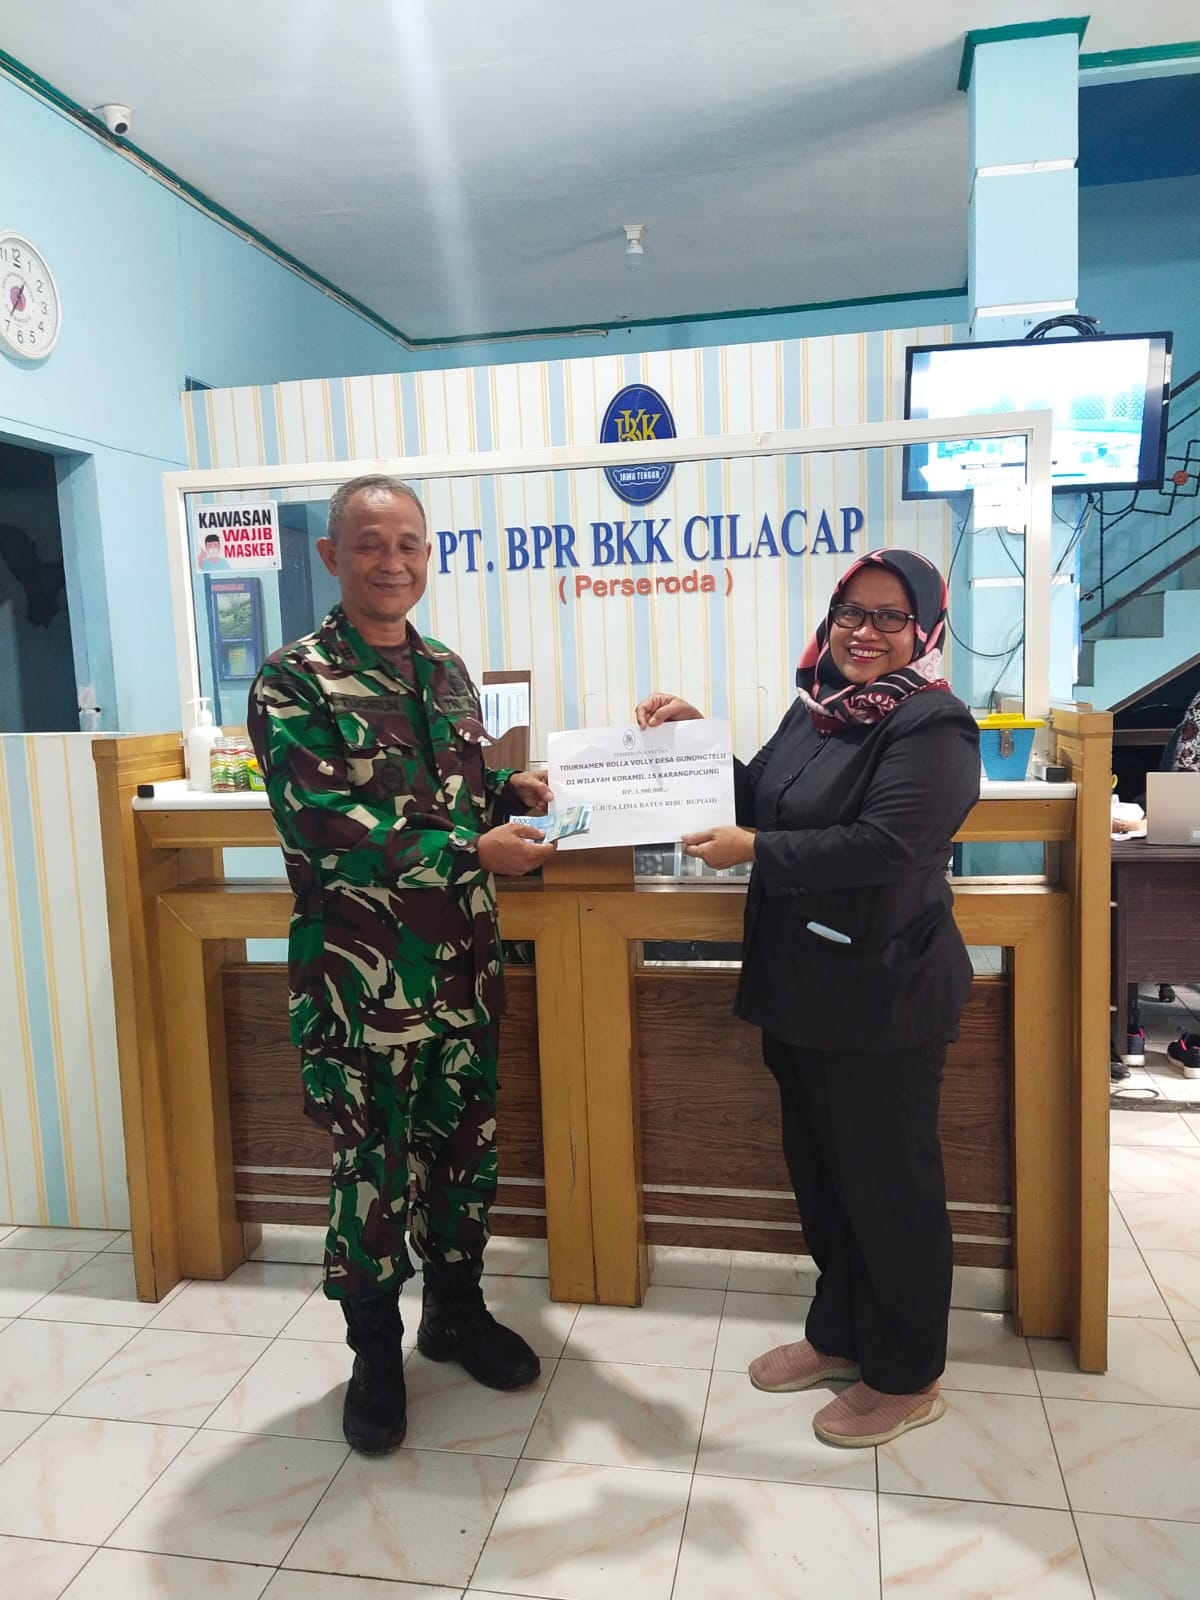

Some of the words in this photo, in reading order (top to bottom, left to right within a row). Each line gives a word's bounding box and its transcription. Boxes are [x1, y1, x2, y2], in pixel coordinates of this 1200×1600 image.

[11, 247, 21, 263] 12
[36, 279, 43, 294] 2
[41, 301, 48, 315] 3
[4, 319, 11, 332] 7
[38, 321, 44, 333] 4
[17, 329, 24, 344] 6
[29, 330, 37, 344] 5
[198, 509, 272, 529] KAWASAN
[222, 527, 273, 542] WAJIB
[436, 528, 495, 575] PT.
[504, 523, 580, 572] BPR
[590, 517, 674, 567] BKK
[683, 506, 865, 562] CILACAP
[223, 542, 274, 558] MASKER
[559, 761, 604, 772] TOURNAMEN
[605, 759, 629, 768] BOLLA
[630, 757, 654, 767] VOLLY
[655, 756, 674, 765] DESA
[675, 752, 727, 763] GUNUNGTELU
[566, 778, 576, 786] DI
[576, 776, 611, 785] WILAYAH
[612, 773, 646, 782] KORAMIL
[647, 772, 657, 780] 15
[658, 767, 720, 779] KARANGPUCUNG
[618, 802, 638, 811] LIMA
[639, 801, 664, 809] RATUS
